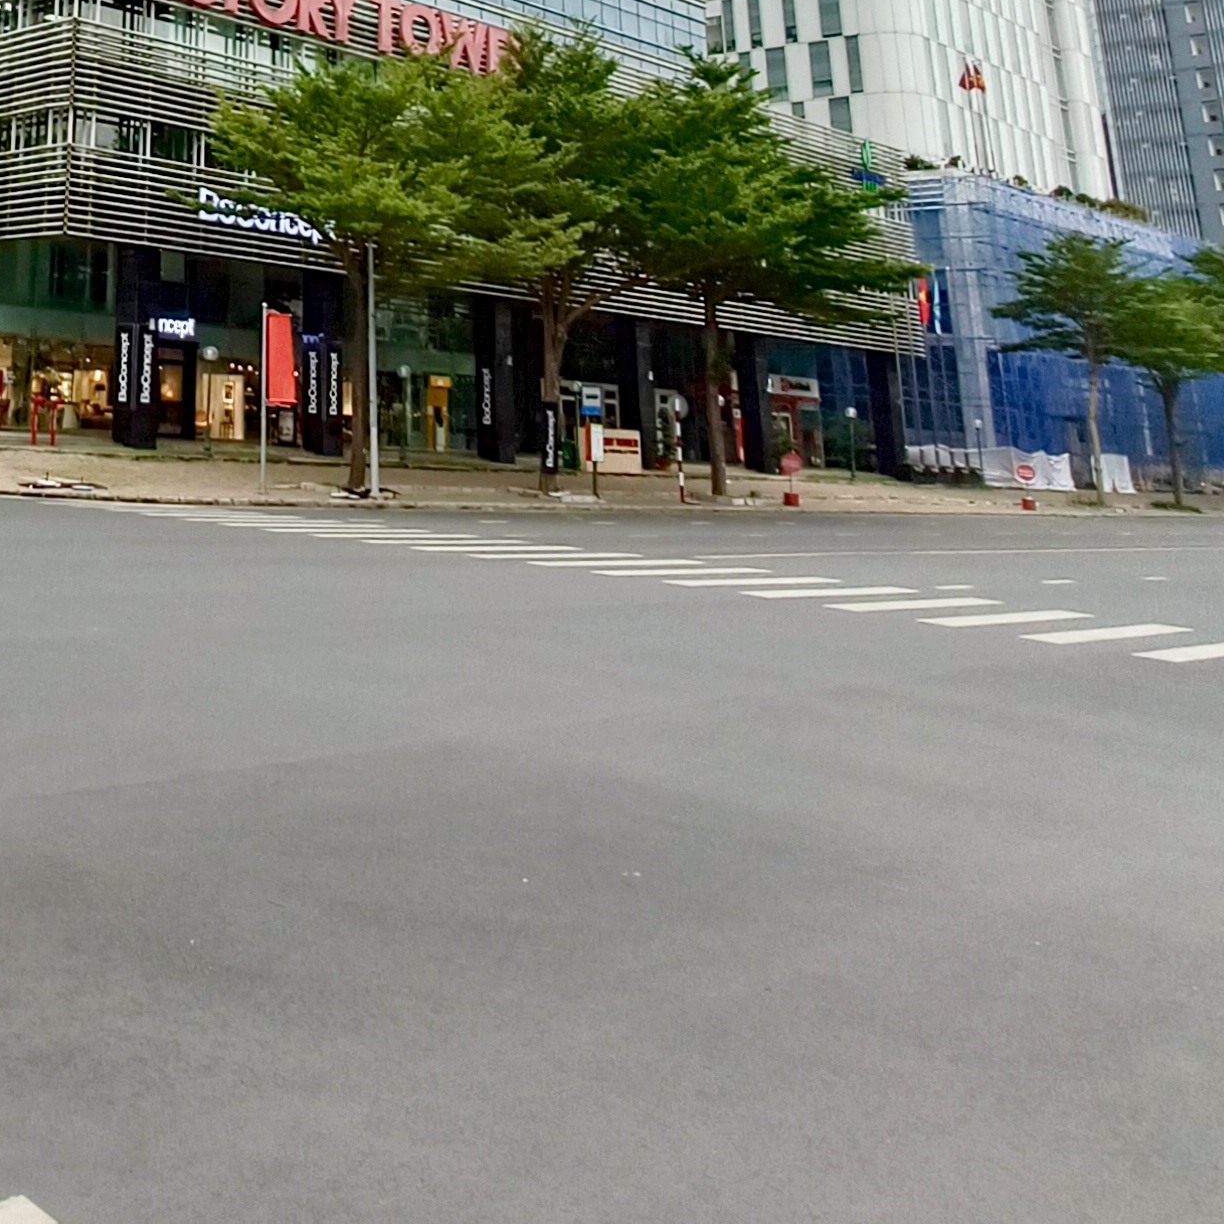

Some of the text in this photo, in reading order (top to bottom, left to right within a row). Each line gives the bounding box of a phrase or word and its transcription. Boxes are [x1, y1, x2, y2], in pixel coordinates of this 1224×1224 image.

[198, 187, 337, 245] BoConce
[118, 332, 130, 403] BoConcept
[140, 333, 154, 403] BoConcept
[308, 351, 319, 414] BoConcept
[329, 352, 340, 415] BoConcept
